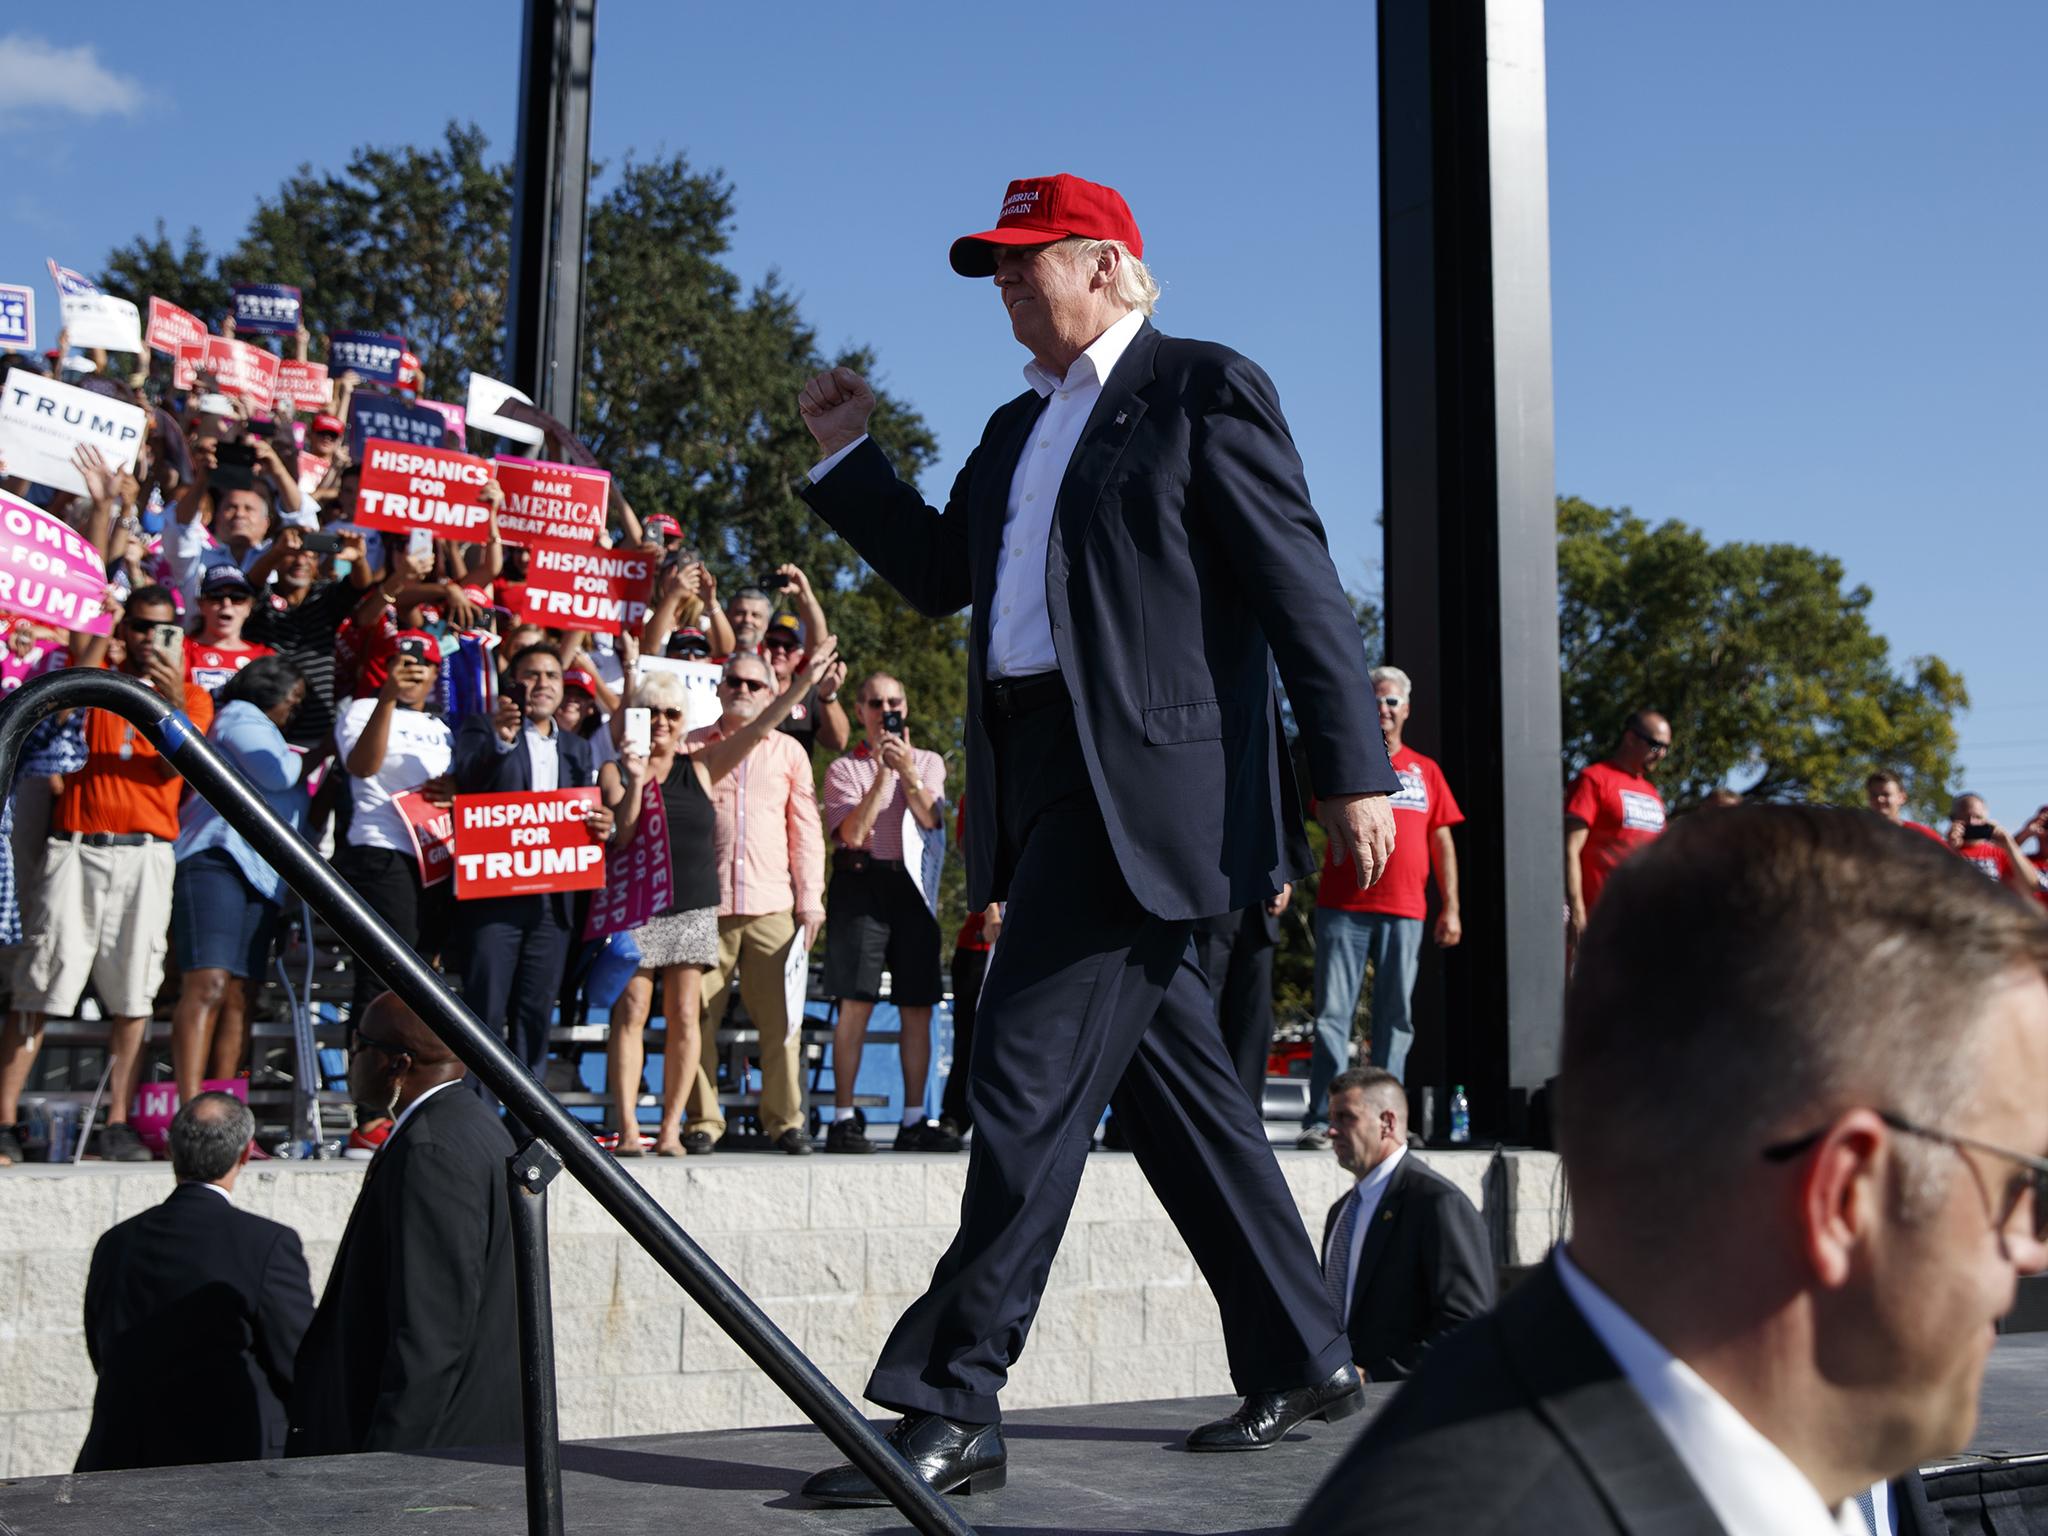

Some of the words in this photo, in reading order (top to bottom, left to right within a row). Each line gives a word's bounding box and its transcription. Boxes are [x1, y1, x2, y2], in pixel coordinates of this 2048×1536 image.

[333, 342, 400, 361] TRUMP
[13, 388, 136, 440] TRUMP
[357, 410, 442, 438] TRUMP
[371, 449, 489, 486] HISPANICS
[409, 477, 446, 497] FOR
[531, 480, 573, 498] MAKE
[360, 488, 490, 528] TRUMP
[0, 505, 104, 574] OMEN
[498, 513, 545, 534] GREAT
[545, 522, 595, 542] AGAIN
[11, 544, 68, 579] FOR
[536, 550, 648, 580] HISPANICS
[0, 570, 101, 624] RUMP
[573, 575, 609, 594] FOR
[526, 587, 648, 623] TRUMP
[464, 798, 594, 829] HISPANICS
[511, 826, 551, 847] FOR
[644, 782, 668, 913] WOMEN
[458, 845, 603, 881] TRUMP
[635, 834, 647, 881] FOR
[611, 854, 629, 924] UMP
